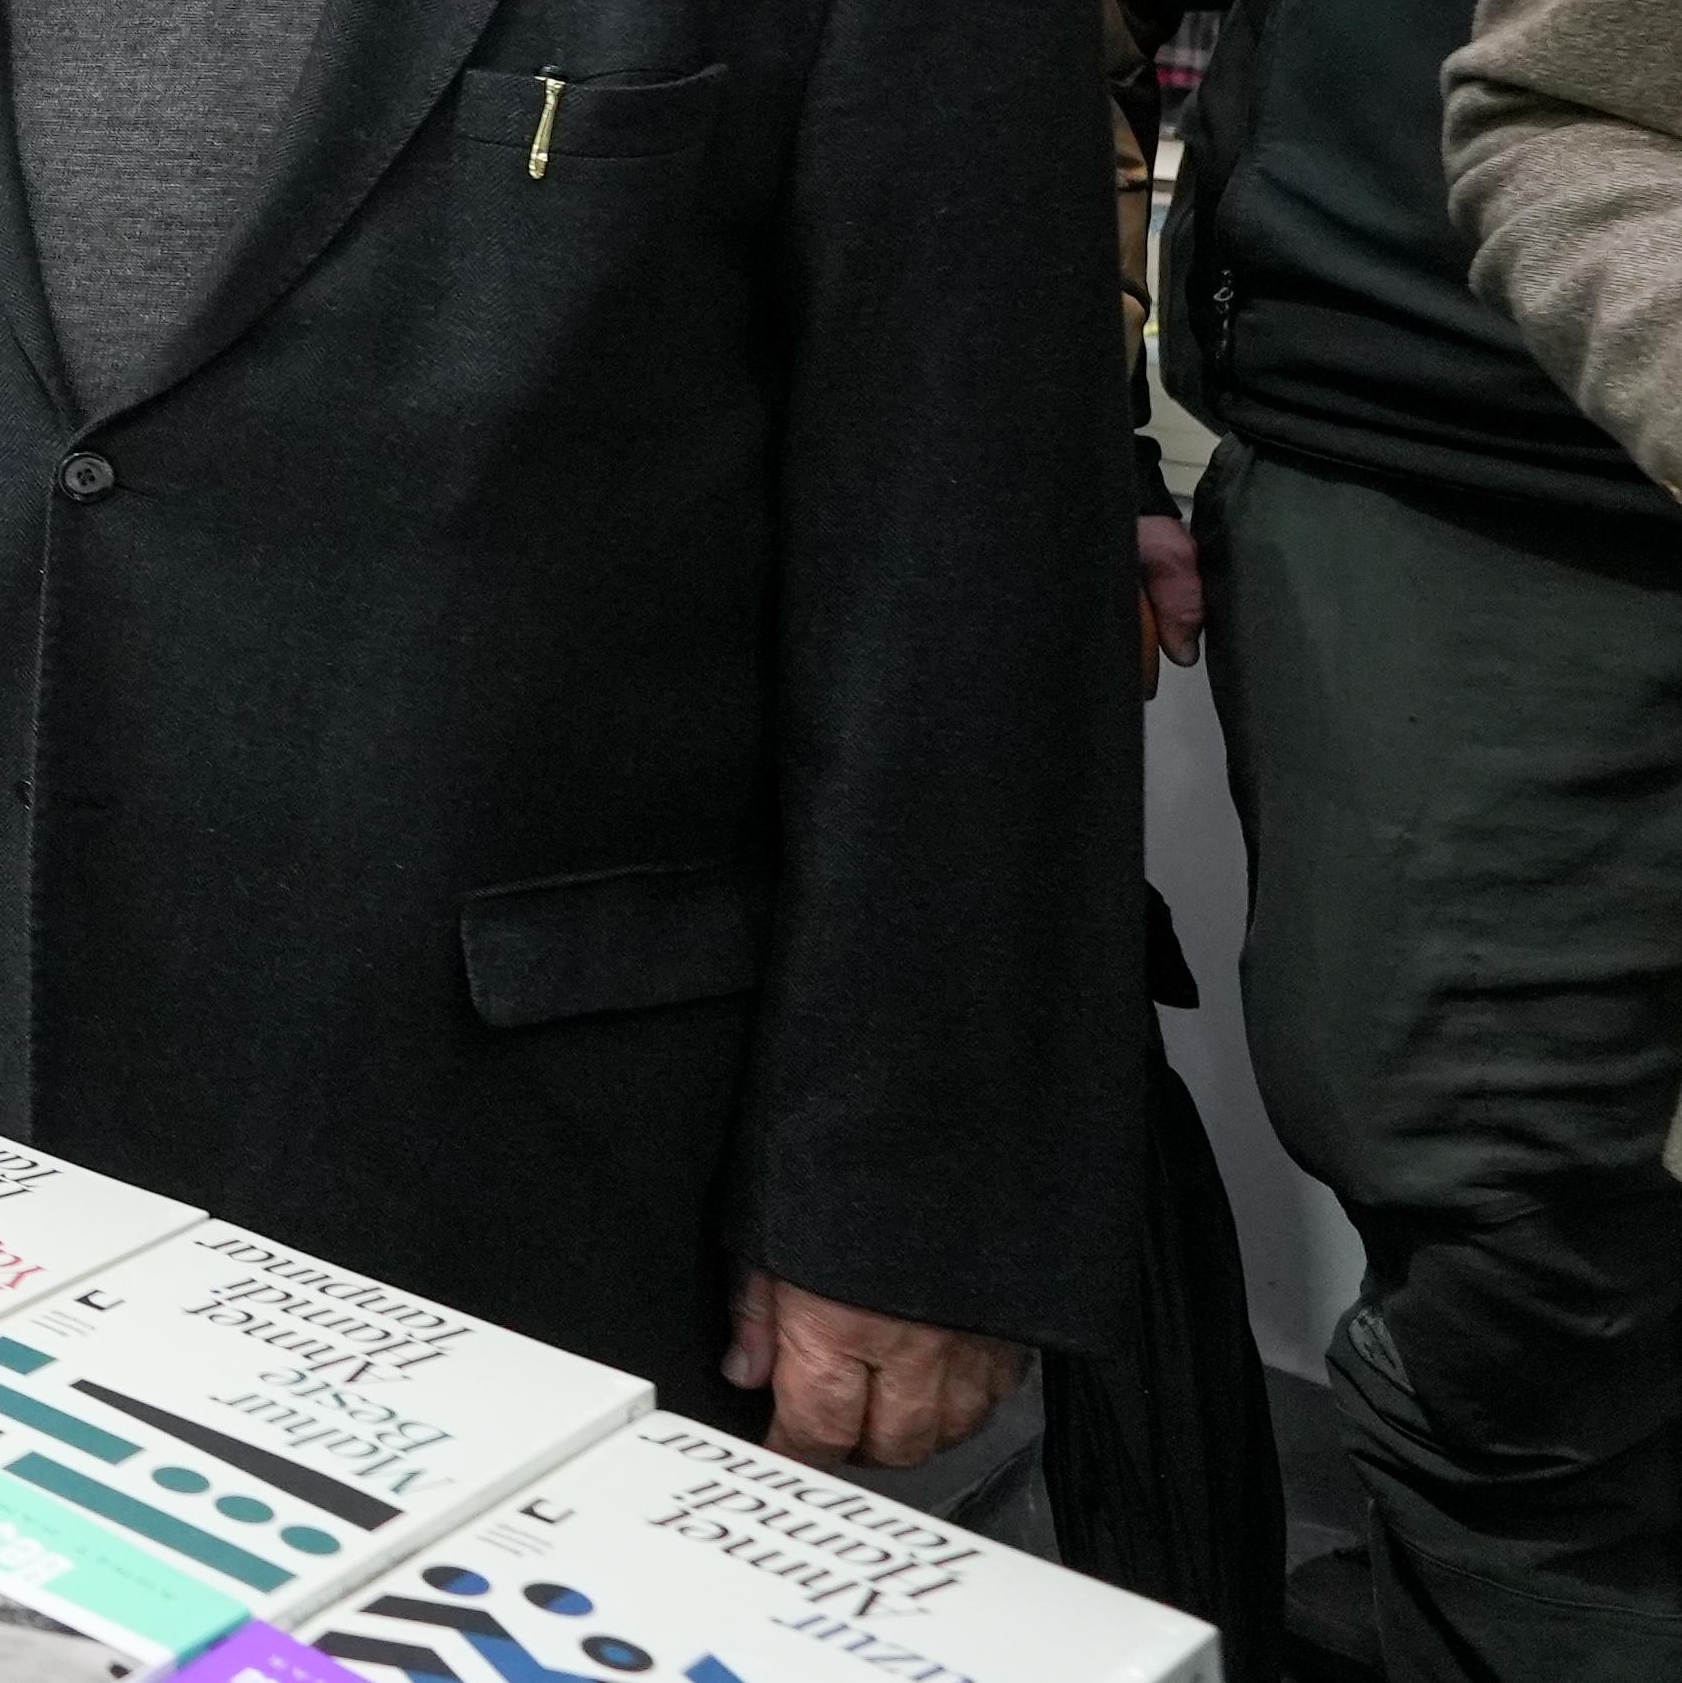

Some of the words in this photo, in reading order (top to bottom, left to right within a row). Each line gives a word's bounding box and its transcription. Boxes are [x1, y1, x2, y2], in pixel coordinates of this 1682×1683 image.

[182, 1299, 413, 1386] Ahmet
[193, 1237, 475, 1350] Tanpınar
[210, 1277, 449, 1370] Hamdi
[208, 1391, 456, 1496] Mahur
[257, 1366, 456, 1454] Beste
[639, 1430, 989, 1567] Tanpınar
[672, 1479, 964, 1602] Hamdi
[648, 1507, 932, 1621] Ahmet
